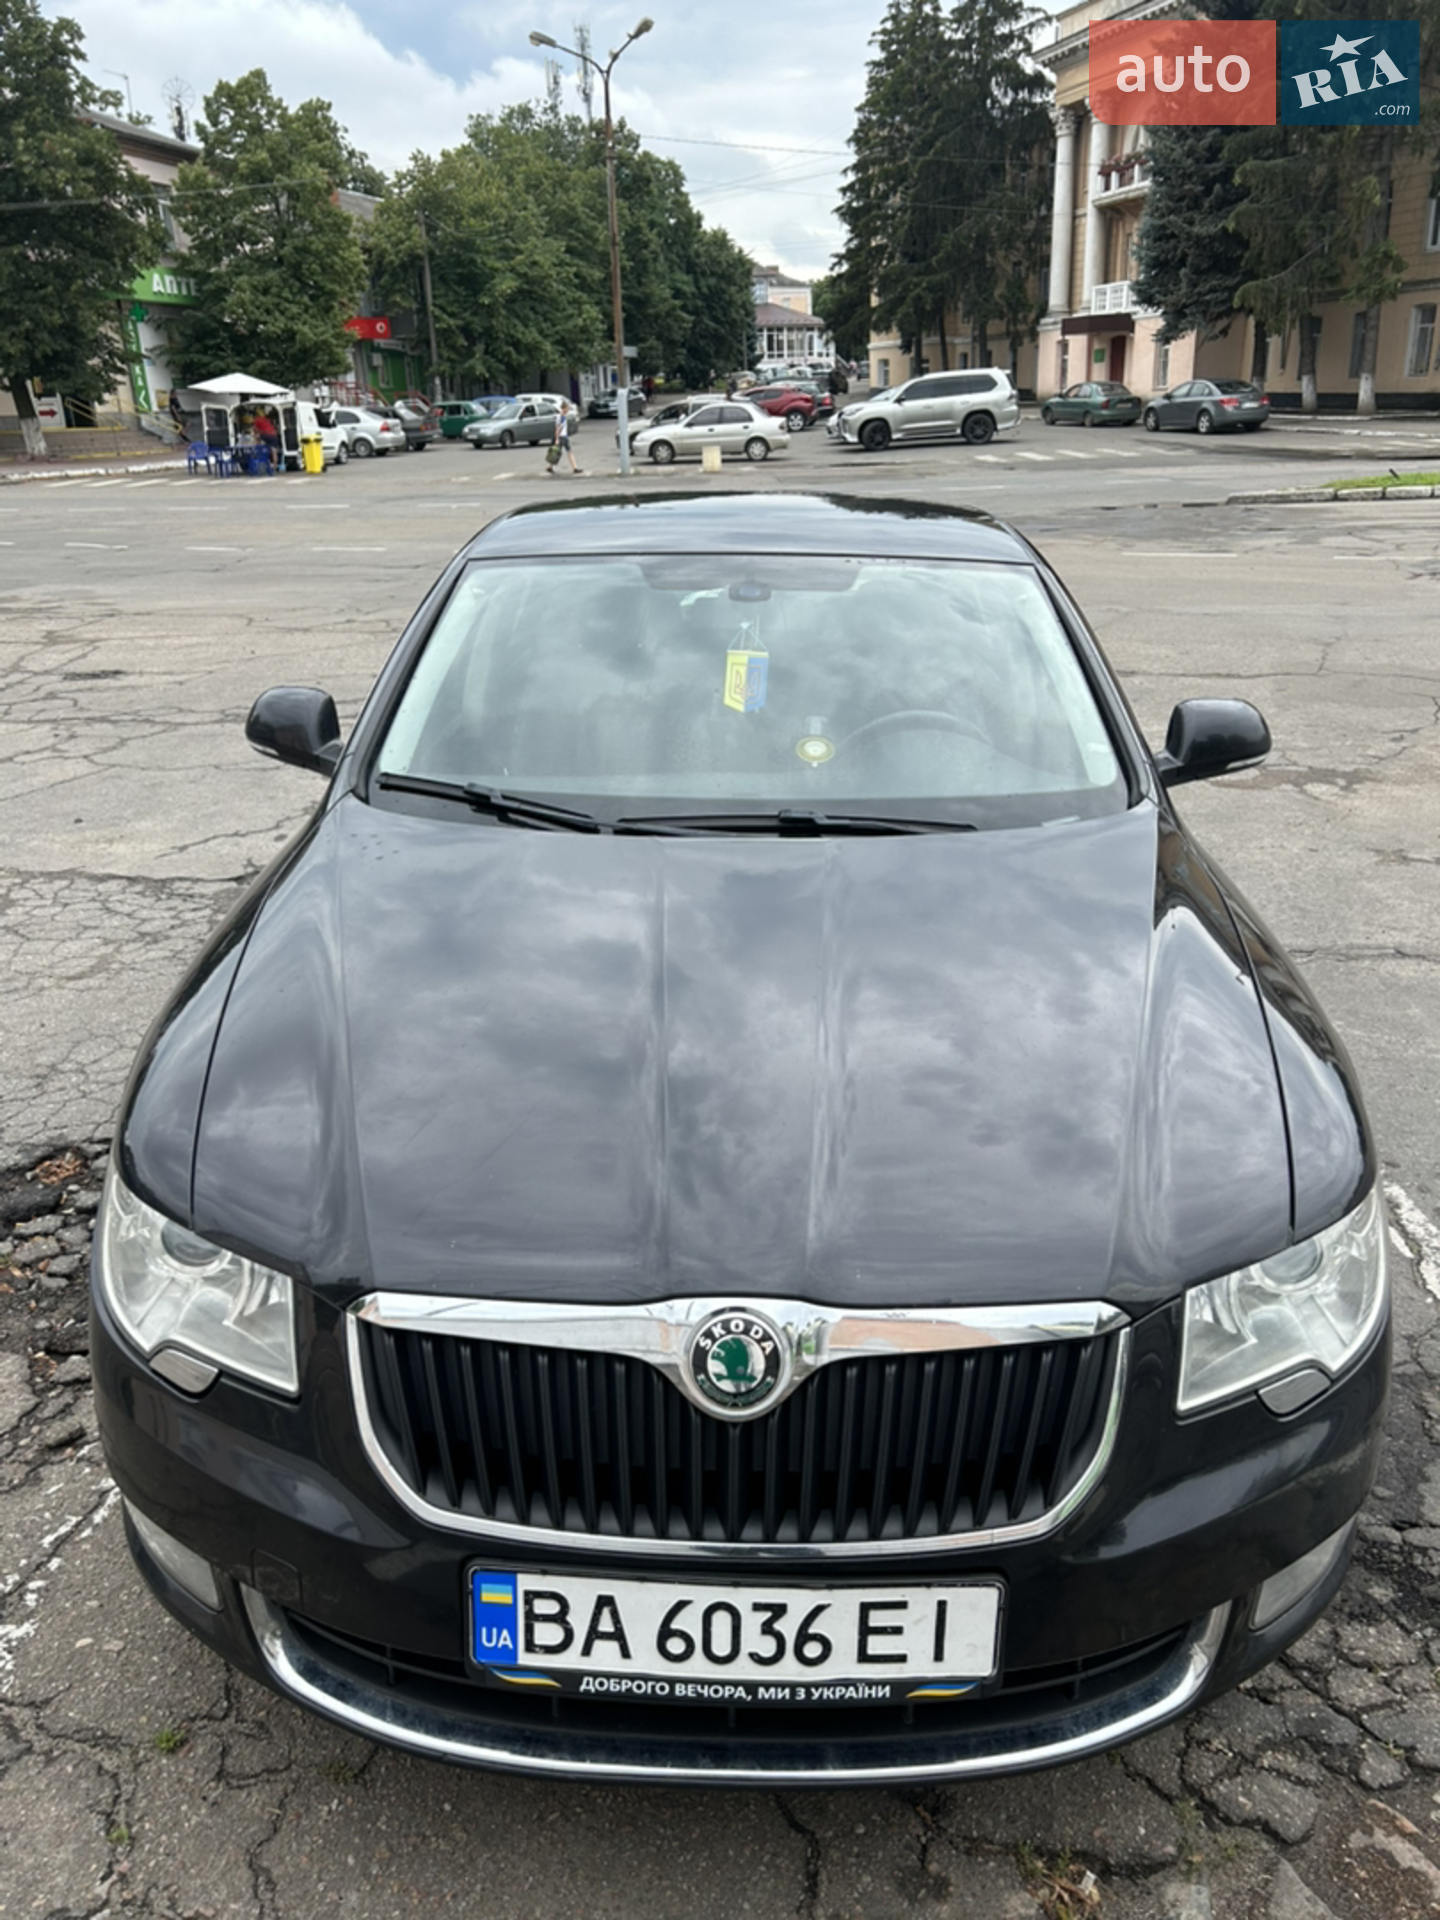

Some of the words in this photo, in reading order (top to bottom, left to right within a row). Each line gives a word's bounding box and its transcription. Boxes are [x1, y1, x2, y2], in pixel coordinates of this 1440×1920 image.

[152, 272, 200, 296] АПТЕ
[481, 1627, 513, 1649] UA
[523, 1589, 632, 1659] BA
[656, 1599, 833, 1667] 6036
[579, 1676, 670, 1695] ДОБРОГО
[674, 1683, 752, 1701] ВЕЧОРА,
[757, 1686, 790, 1700] МИ
[810, 1683, 891, 1700] УКРАЇНИ
